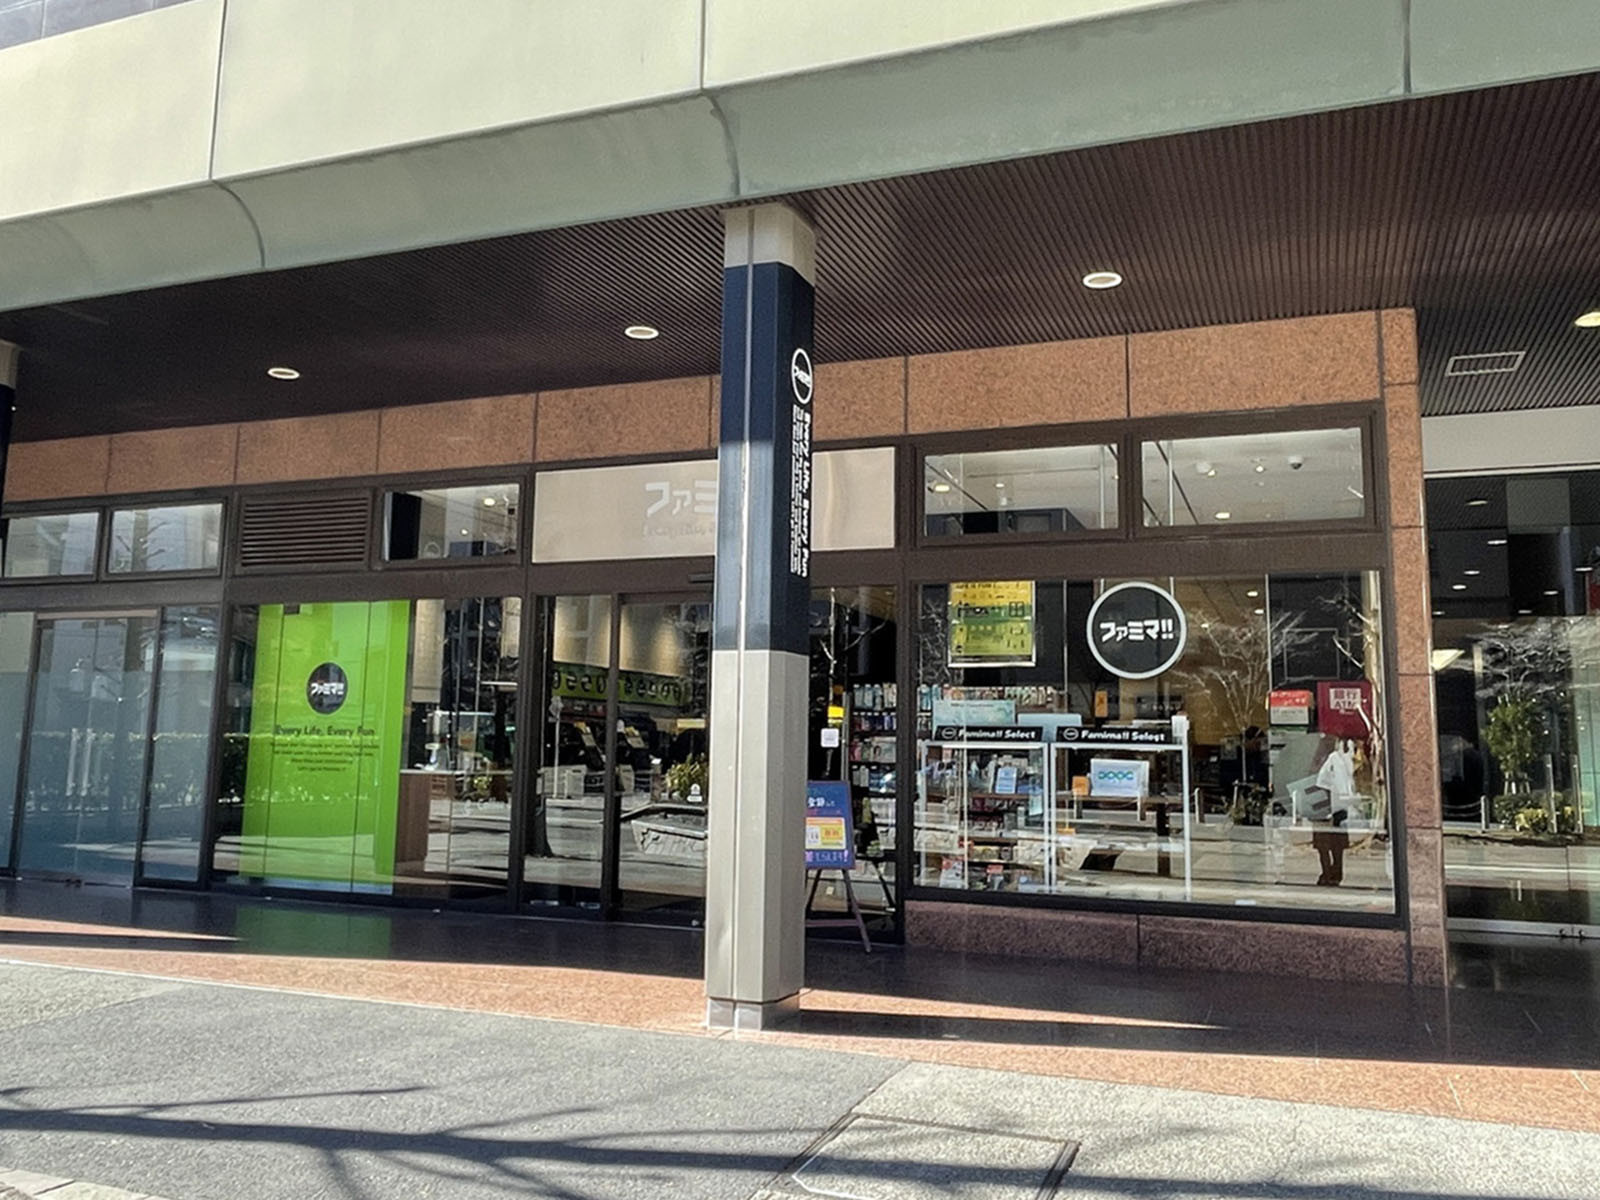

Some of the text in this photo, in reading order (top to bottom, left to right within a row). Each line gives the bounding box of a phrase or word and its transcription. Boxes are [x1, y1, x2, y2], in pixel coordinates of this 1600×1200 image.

[800, 412, 811, 457] Every
[802, 460, 811, 493] Life,
[800, 498, 810, 545] Every
[801, 547, 809, 578] Fun
[1099, 618, 1174, 643] ファミマ!!
[275, 725, 301, 737] Every
[327, 726, 354, 738] Every
[357, 726, 375, 736] Fun
[1004, 729, 1036, 739] Select
[1081, 730, 1130, 740] Famima!!
[1131, 731, 1165, 742] Select
